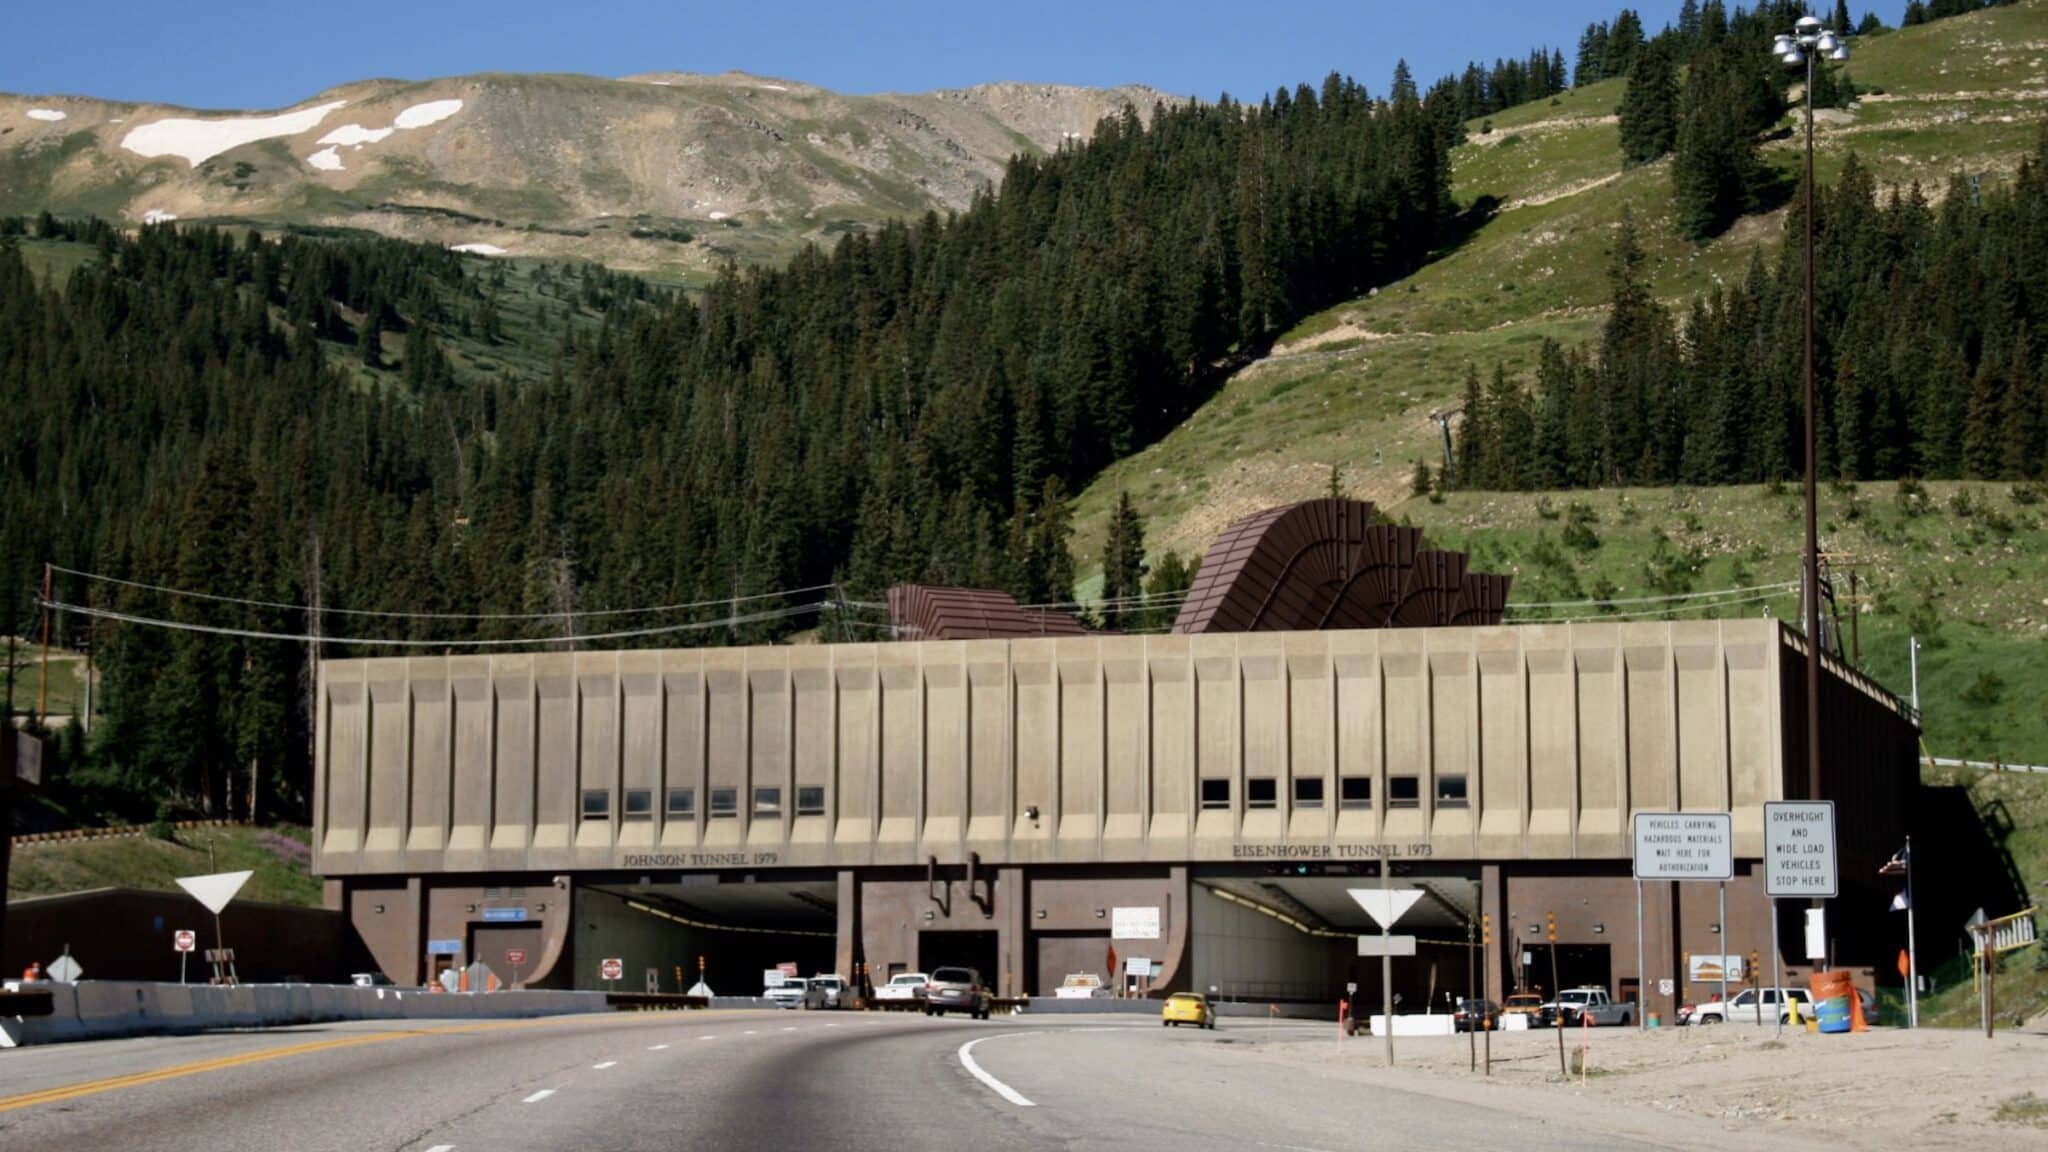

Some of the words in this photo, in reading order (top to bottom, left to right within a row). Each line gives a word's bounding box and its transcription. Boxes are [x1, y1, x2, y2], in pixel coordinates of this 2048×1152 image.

[1773, 811, 1825, 822] OVERHEIGHT
[1649, 820, 1679, 829] VEHICLES
[1684, 820, 1717, 829] CARRYING
[1791, 828, 1808, 838] AND
[1644, 834, 1681, 843] HAZARDOUS
[1687, 834, 1722, 844] MATERIALS
[1232, 844, 1331, 857] EISENHOWER
[1337, 844, 1402, 857] TUNNEL
[1407, 844, 1432, 857] 1973
[1656, 849, 1671, 857] WAIT
[1676, 849, 1692, 857] HERE
[1697, 849, 1711, 858] FOR
[1776, 844, 1798, 854] WIDE
[1802, 844, 1825, 854] LOAD
[623, 853, 685, 866] JOHNSON
[691, 853, 748, 865] TUNNEL
[753, 852, 777, 865] 1979
[1659, 863, 1709, 872] AUTHORIZATION
[1780, 860, 1821, 870] VEHICLES
[1776, 876, 1798, 886] STOP
[1801, 876, 1825, 886] HERE
